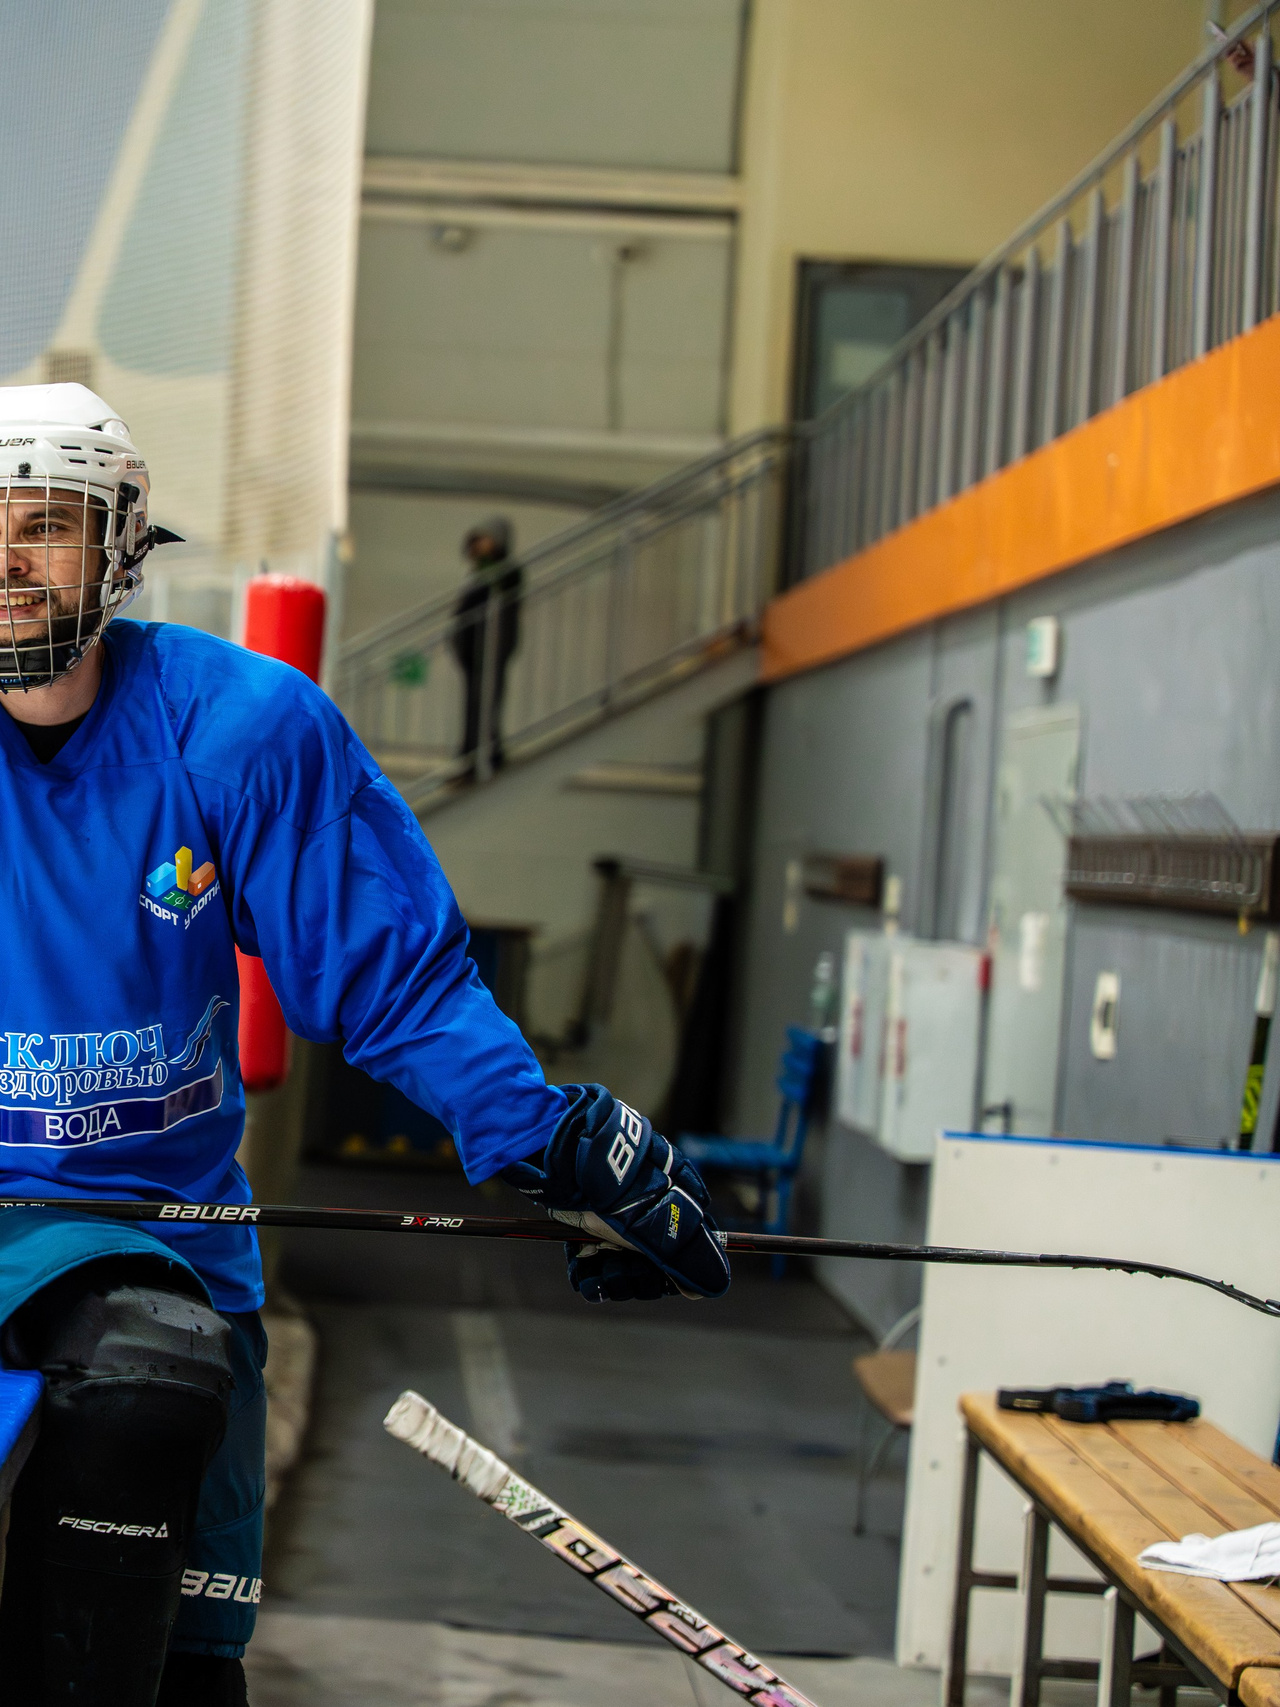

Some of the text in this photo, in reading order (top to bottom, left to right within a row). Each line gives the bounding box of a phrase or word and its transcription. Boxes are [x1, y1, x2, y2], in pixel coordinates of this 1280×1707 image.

[139, 893, 179, 926] СПОРТ
[4, 1023, 167, 1071] КЛЮЧ
[45, 1106, 122, 1141] ВОДА
[58, 1516, 156, 1538] FISCHER
